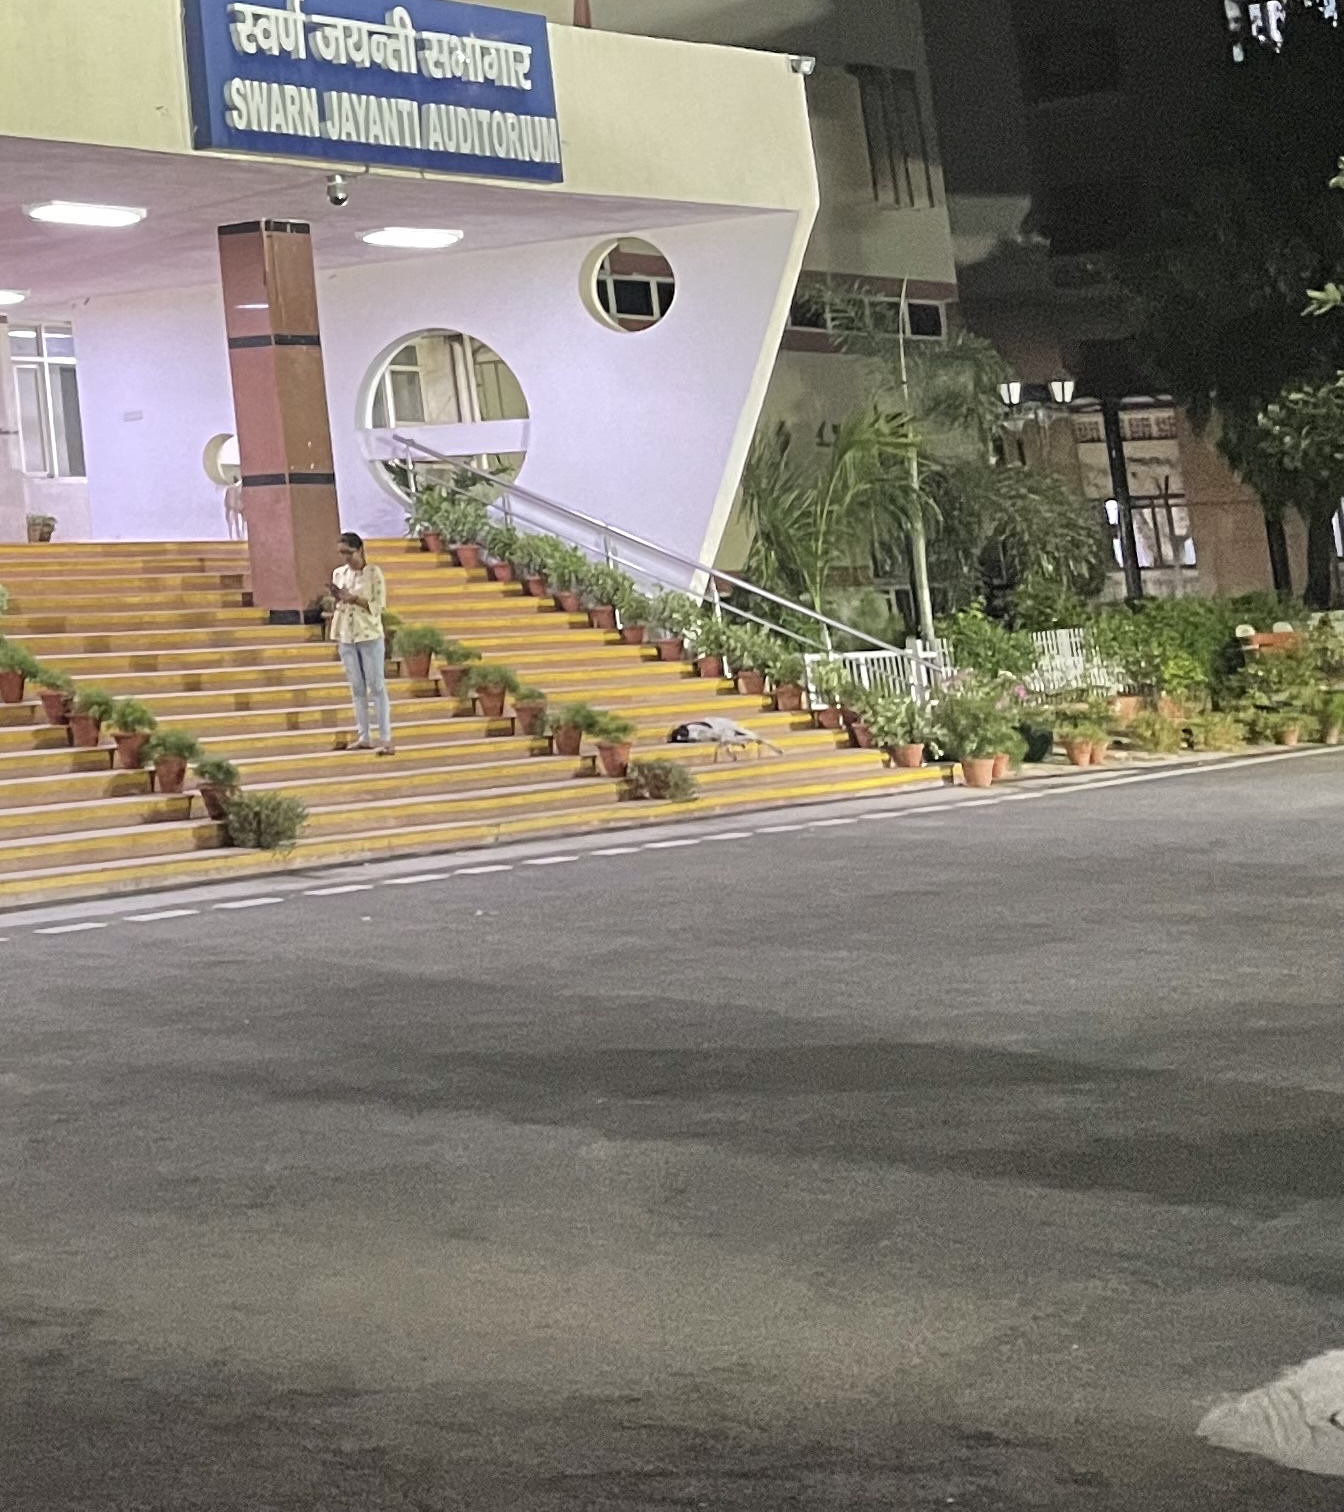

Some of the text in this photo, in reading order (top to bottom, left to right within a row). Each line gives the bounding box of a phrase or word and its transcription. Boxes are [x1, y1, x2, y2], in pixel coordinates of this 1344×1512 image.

[309, 6, 419, 74] जयन्ती
[417, 31, 533, 90] सभागार
[225, 77, 561, 164] SWARN JAYANTI AUDITORIUM
